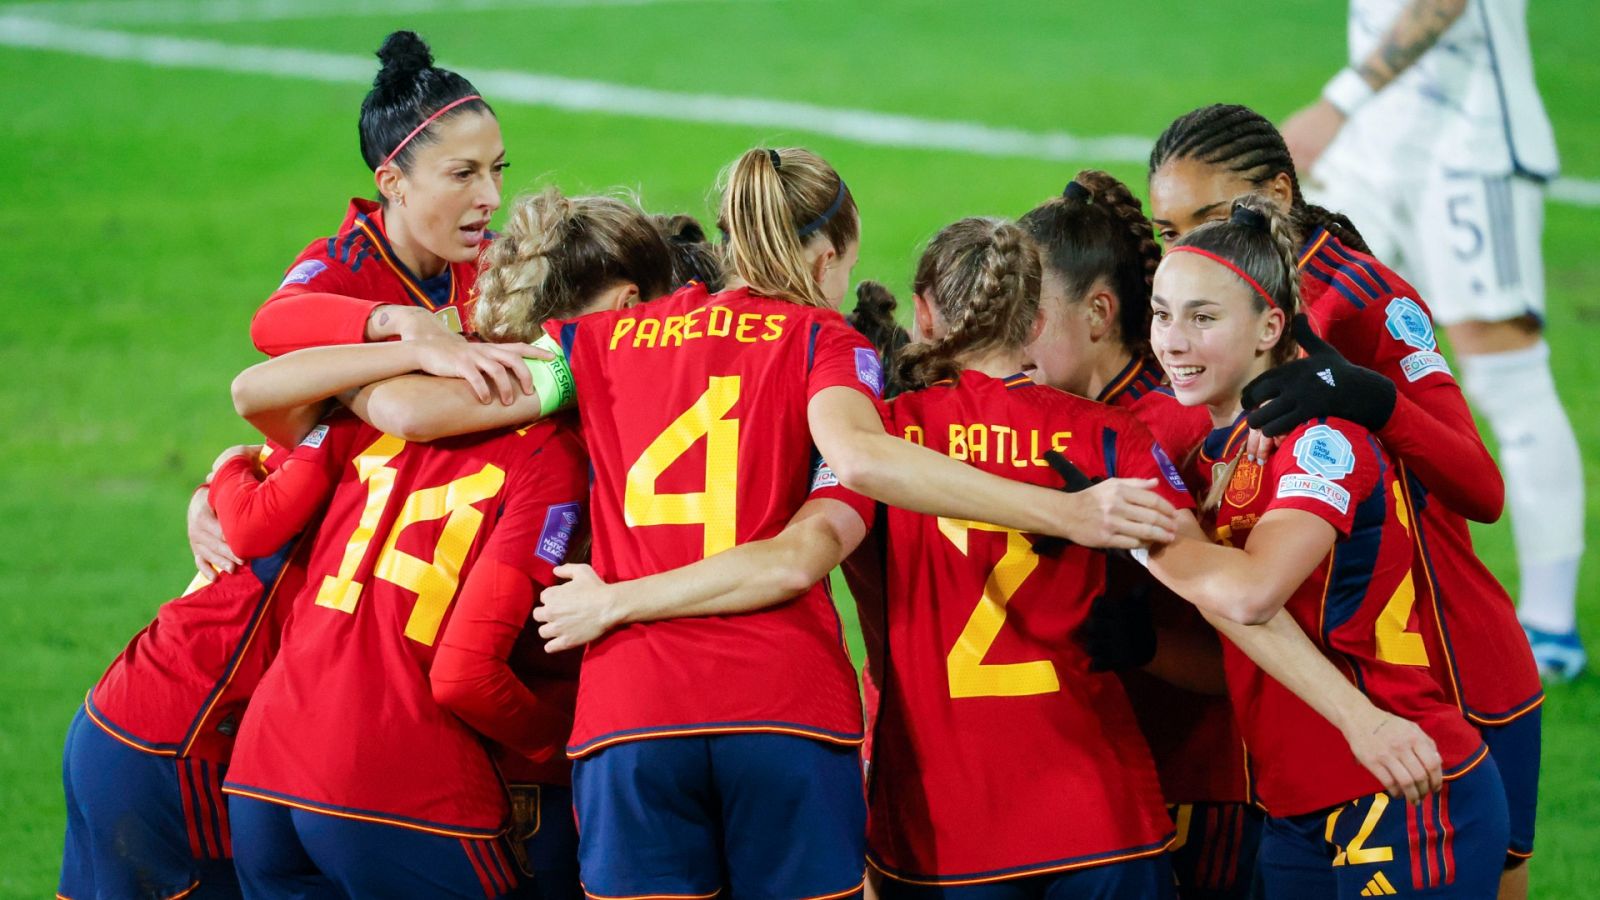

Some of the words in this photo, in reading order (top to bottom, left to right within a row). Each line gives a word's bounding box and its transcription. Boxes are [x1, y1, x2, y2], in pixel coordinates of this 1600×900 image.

[1446, 194, 1484, 261] 5
[608, 305, 788, 351] PAREDES
[623, 374, 742, 560] 4
[1279, 480, 1349, 506] FOUNDATION
[314, 433, 506, 647] 14
[937, 516, 1060, 699] 2
